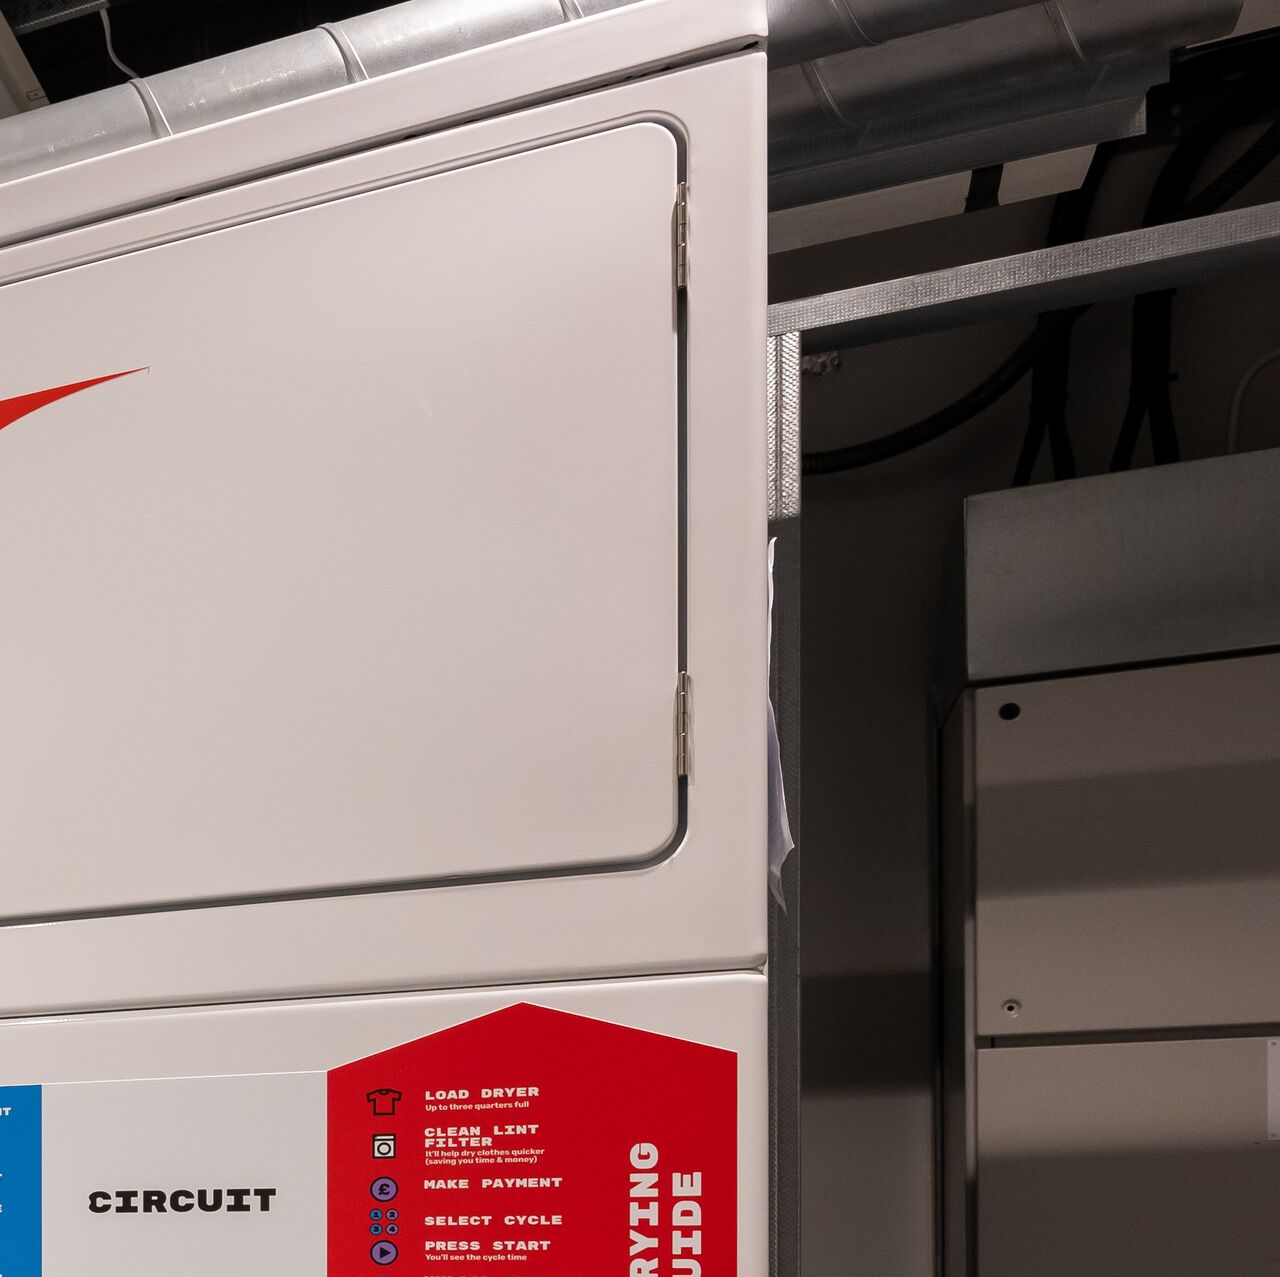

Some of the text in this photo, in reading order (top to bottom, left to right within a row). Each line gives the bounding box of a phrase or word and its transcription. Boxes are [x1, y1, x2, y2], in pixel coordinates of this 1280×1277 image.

[425, 1086, 539, 1100] LOAD DRYER
[425, 1104, 437, 1112] Up
[474, 1102, 513, 1110] quarters
[424, 1124, 539, 1138] CLEAN LINT
[424, 1136, 492, 1148] FILTER
[423, 1177, 562, 1189] MAKE PAYMENT
[88, 1188, 276, 1213] CIRCUIT
[424, 1215, 562, 1226] SELECT CYCLE
[425, 1240, 550, 1250] PRESS START
[482, 1253, 506, 1261] cycle
